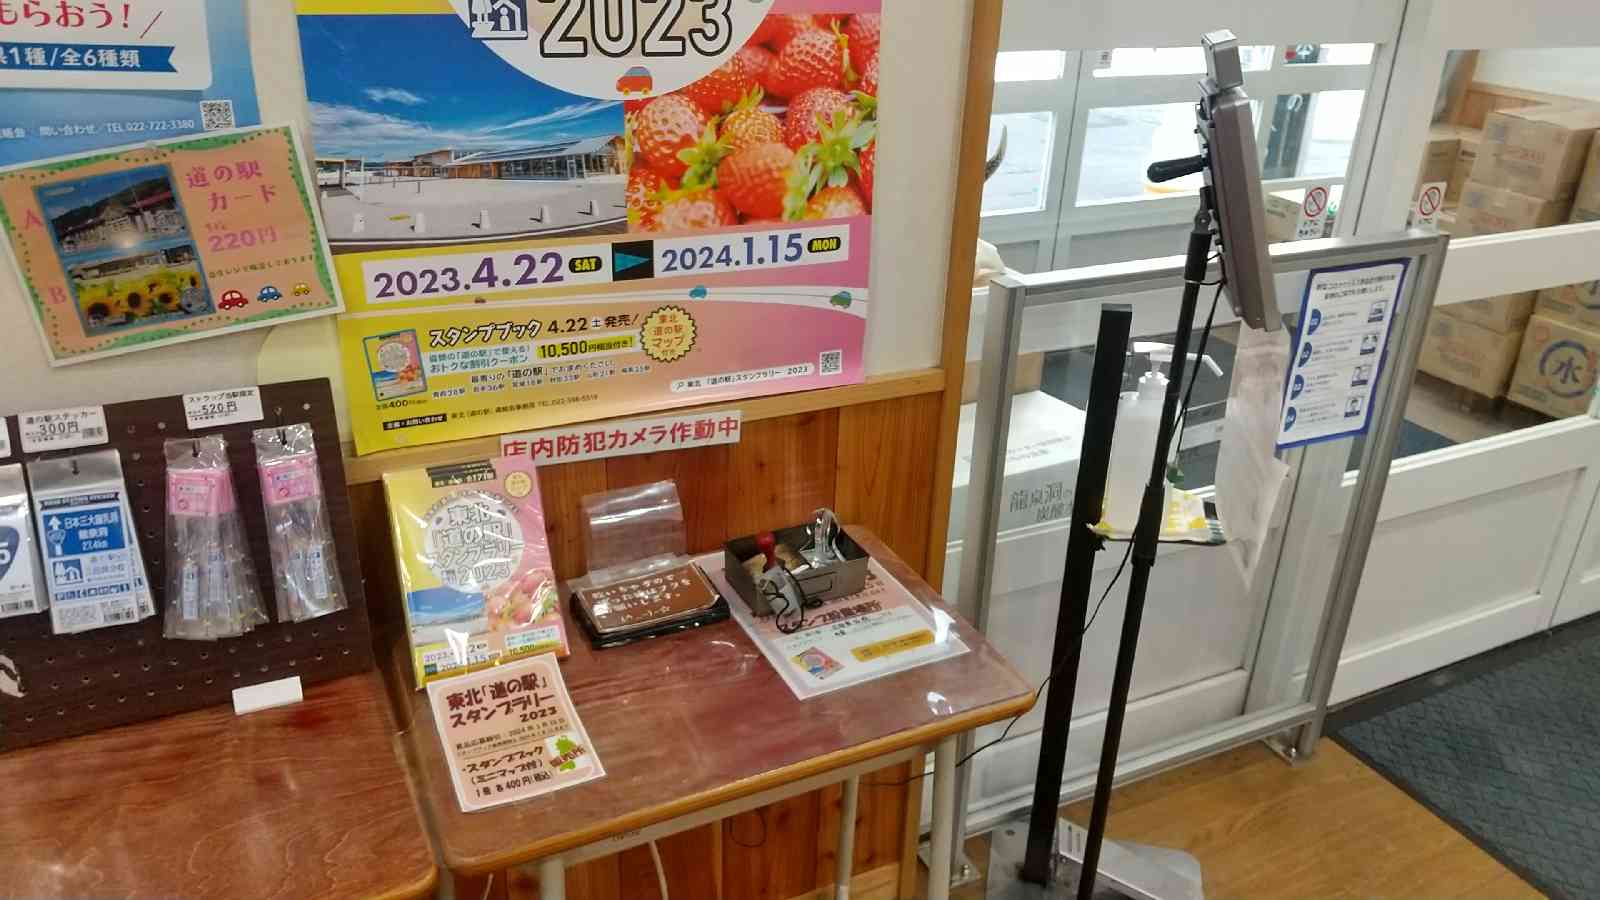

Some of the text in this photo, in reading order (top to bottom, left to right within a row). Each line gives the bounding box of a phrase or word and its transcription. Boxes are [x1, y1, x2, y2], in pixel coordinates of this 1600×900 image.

[540, 0, 733, 58] 2023
[186, 160, 263, 188] 道の駅
[207, 184, 276, 212] カード
[208, 225, 278, 253] 220円
[373, 233, 838, 299] 2023.4.22 SAT 2024.1.15 MON
[652, 324, 683, 336] 道の駅
[658, 313, 679, 323] 東北
[428, 319, 541, 348] スタンプブック
[547, 317, 588, 334] 4.22
[651, 337, 684, 348] マップ
[430, 356, 529, 373] おトクな割引クーポン
[787, 366, 808, 375] 2023
[1551, 356, 1584, 384] 水
[201, 400, 239, 415] 520円
[39, 420, 80, 436] 300円
[503, 416, 739, 461] 店内防犯カメラ作動中
[446, 672, 549, 711] 東北「道の駅」
[450, 692, 556, 728] スタンプラリー
[520, 705, 559, 723] 2023
